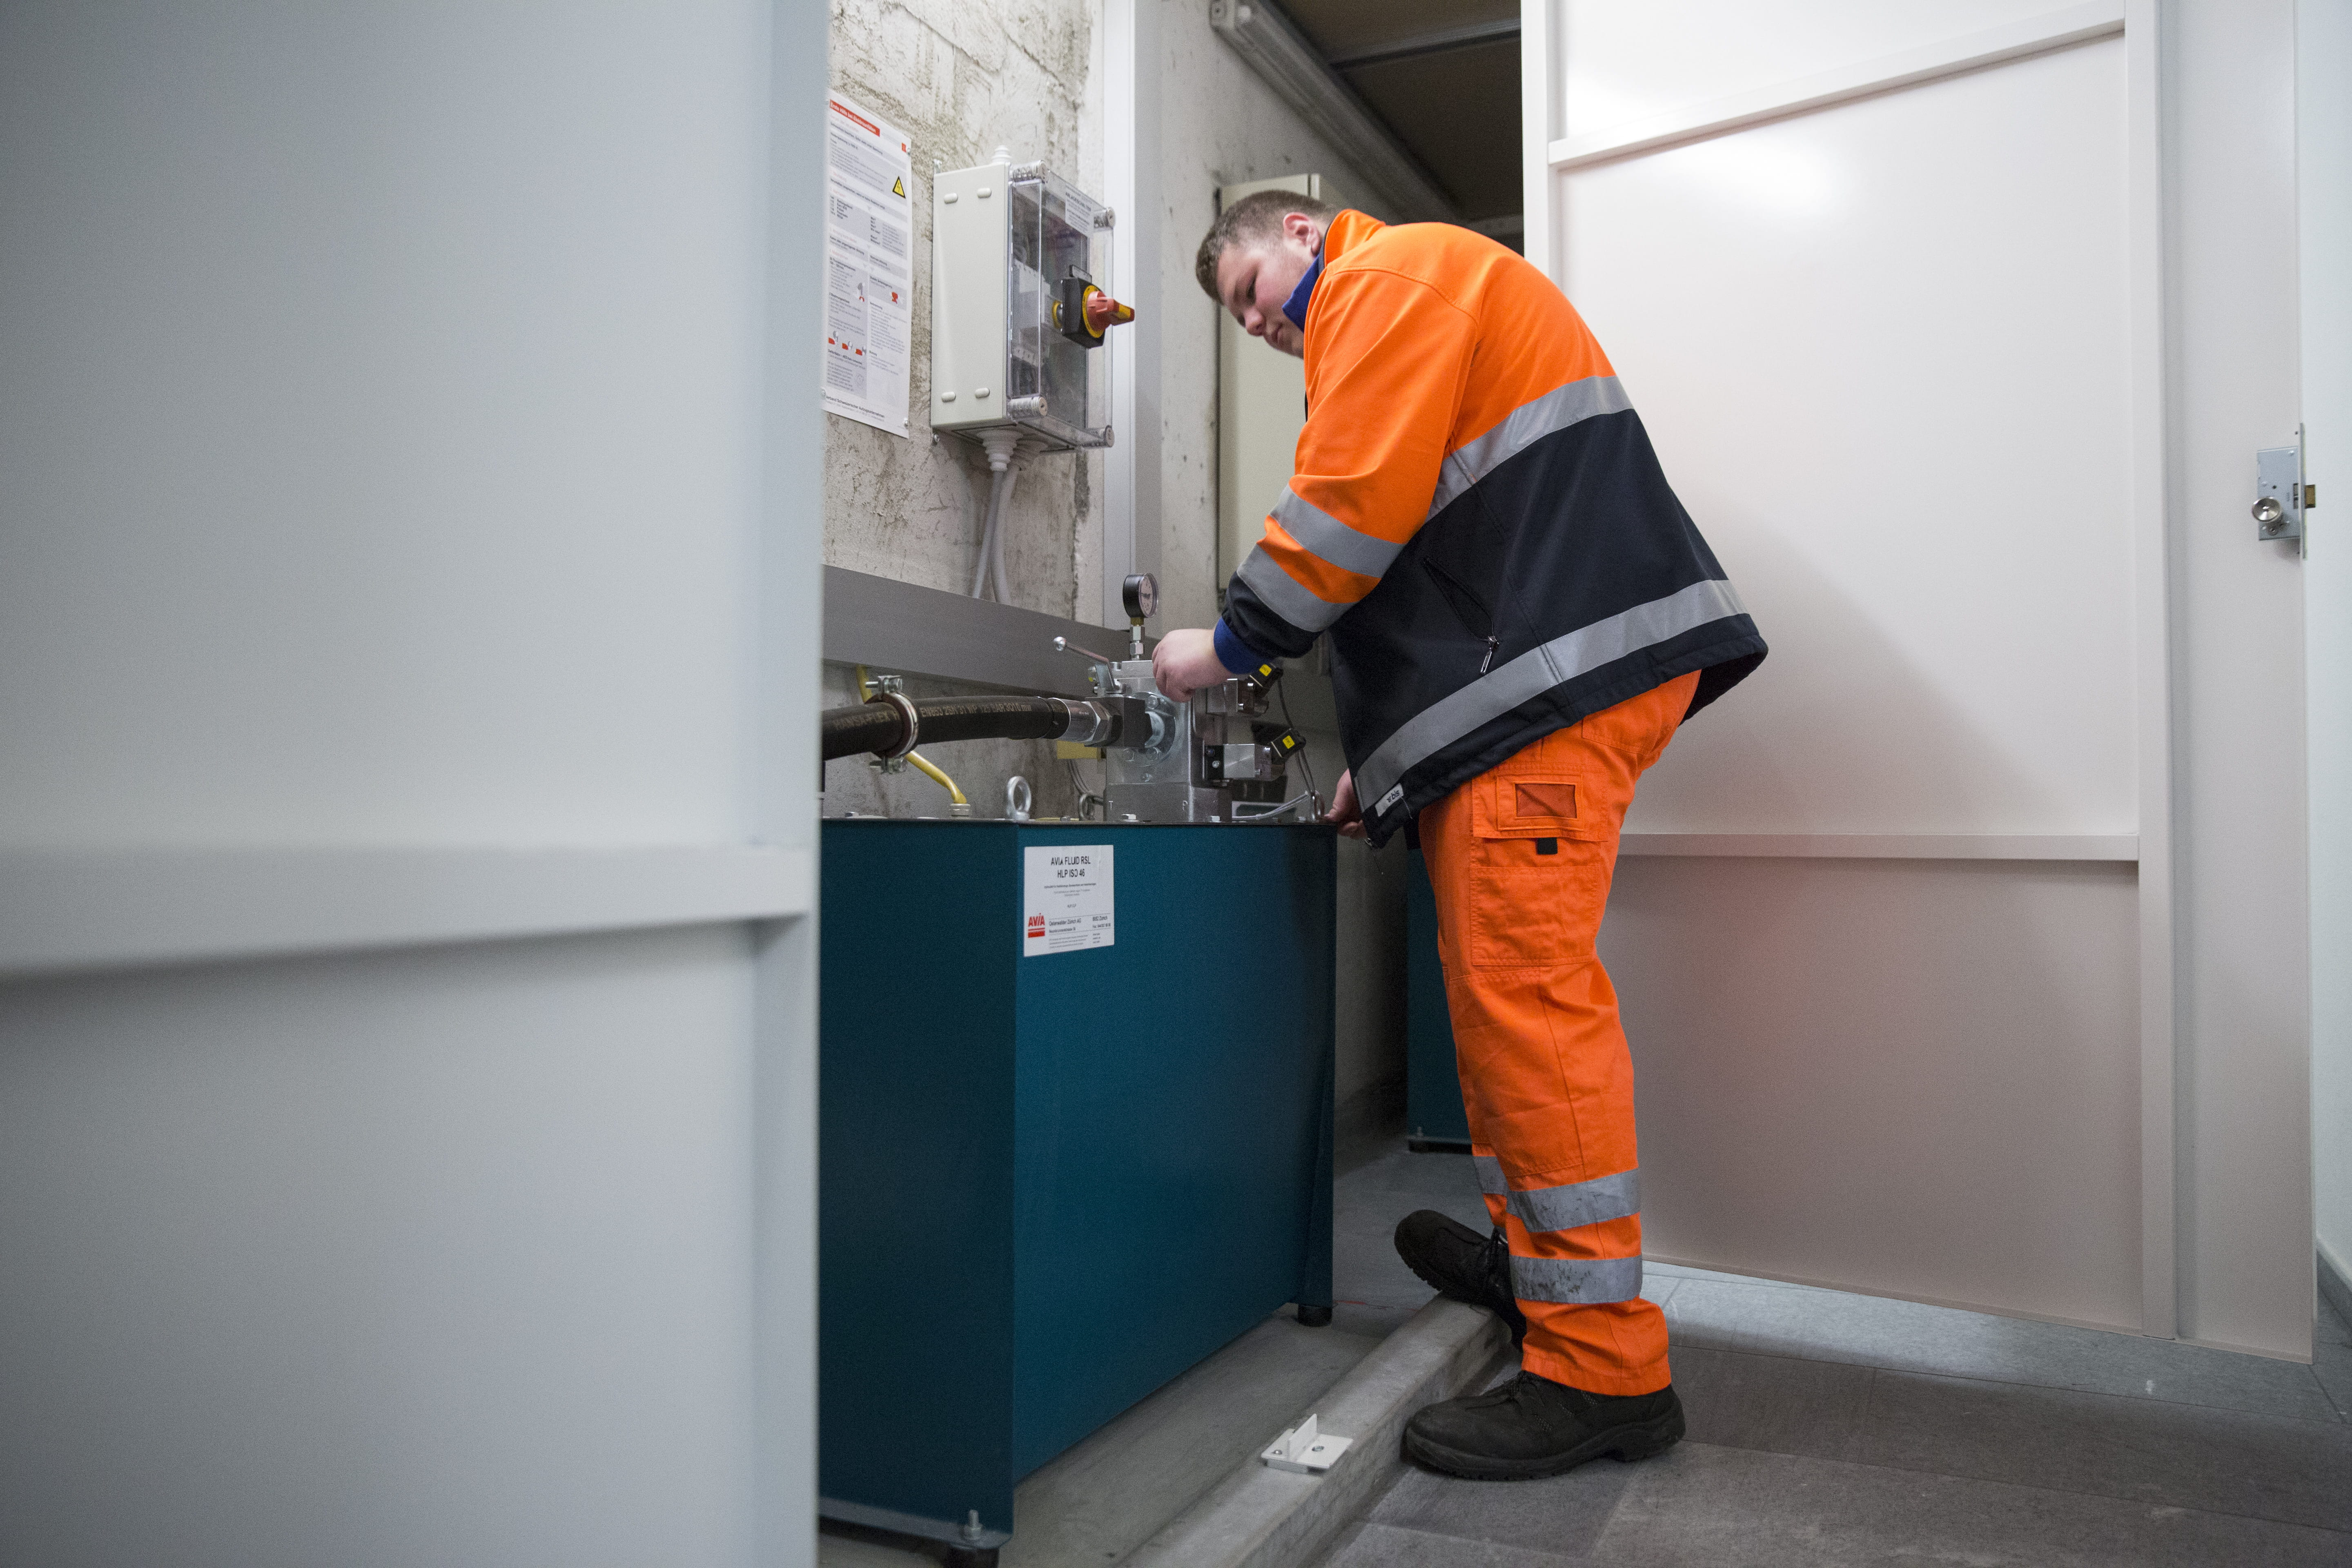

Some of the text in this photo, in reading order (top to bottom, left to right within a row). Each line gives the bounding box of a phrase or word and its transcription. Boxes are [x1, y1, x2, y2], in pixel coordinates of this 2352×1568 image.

[831, 102, 839, 111] Erste
[1391, 790, 1400, 800] bls
[1051, 856, 1091, 865] AVIA FLUID RSL
[1058, 869, 1085, 878] HLP ISO 46
[1028, 913, 1045, 927] AVIA
